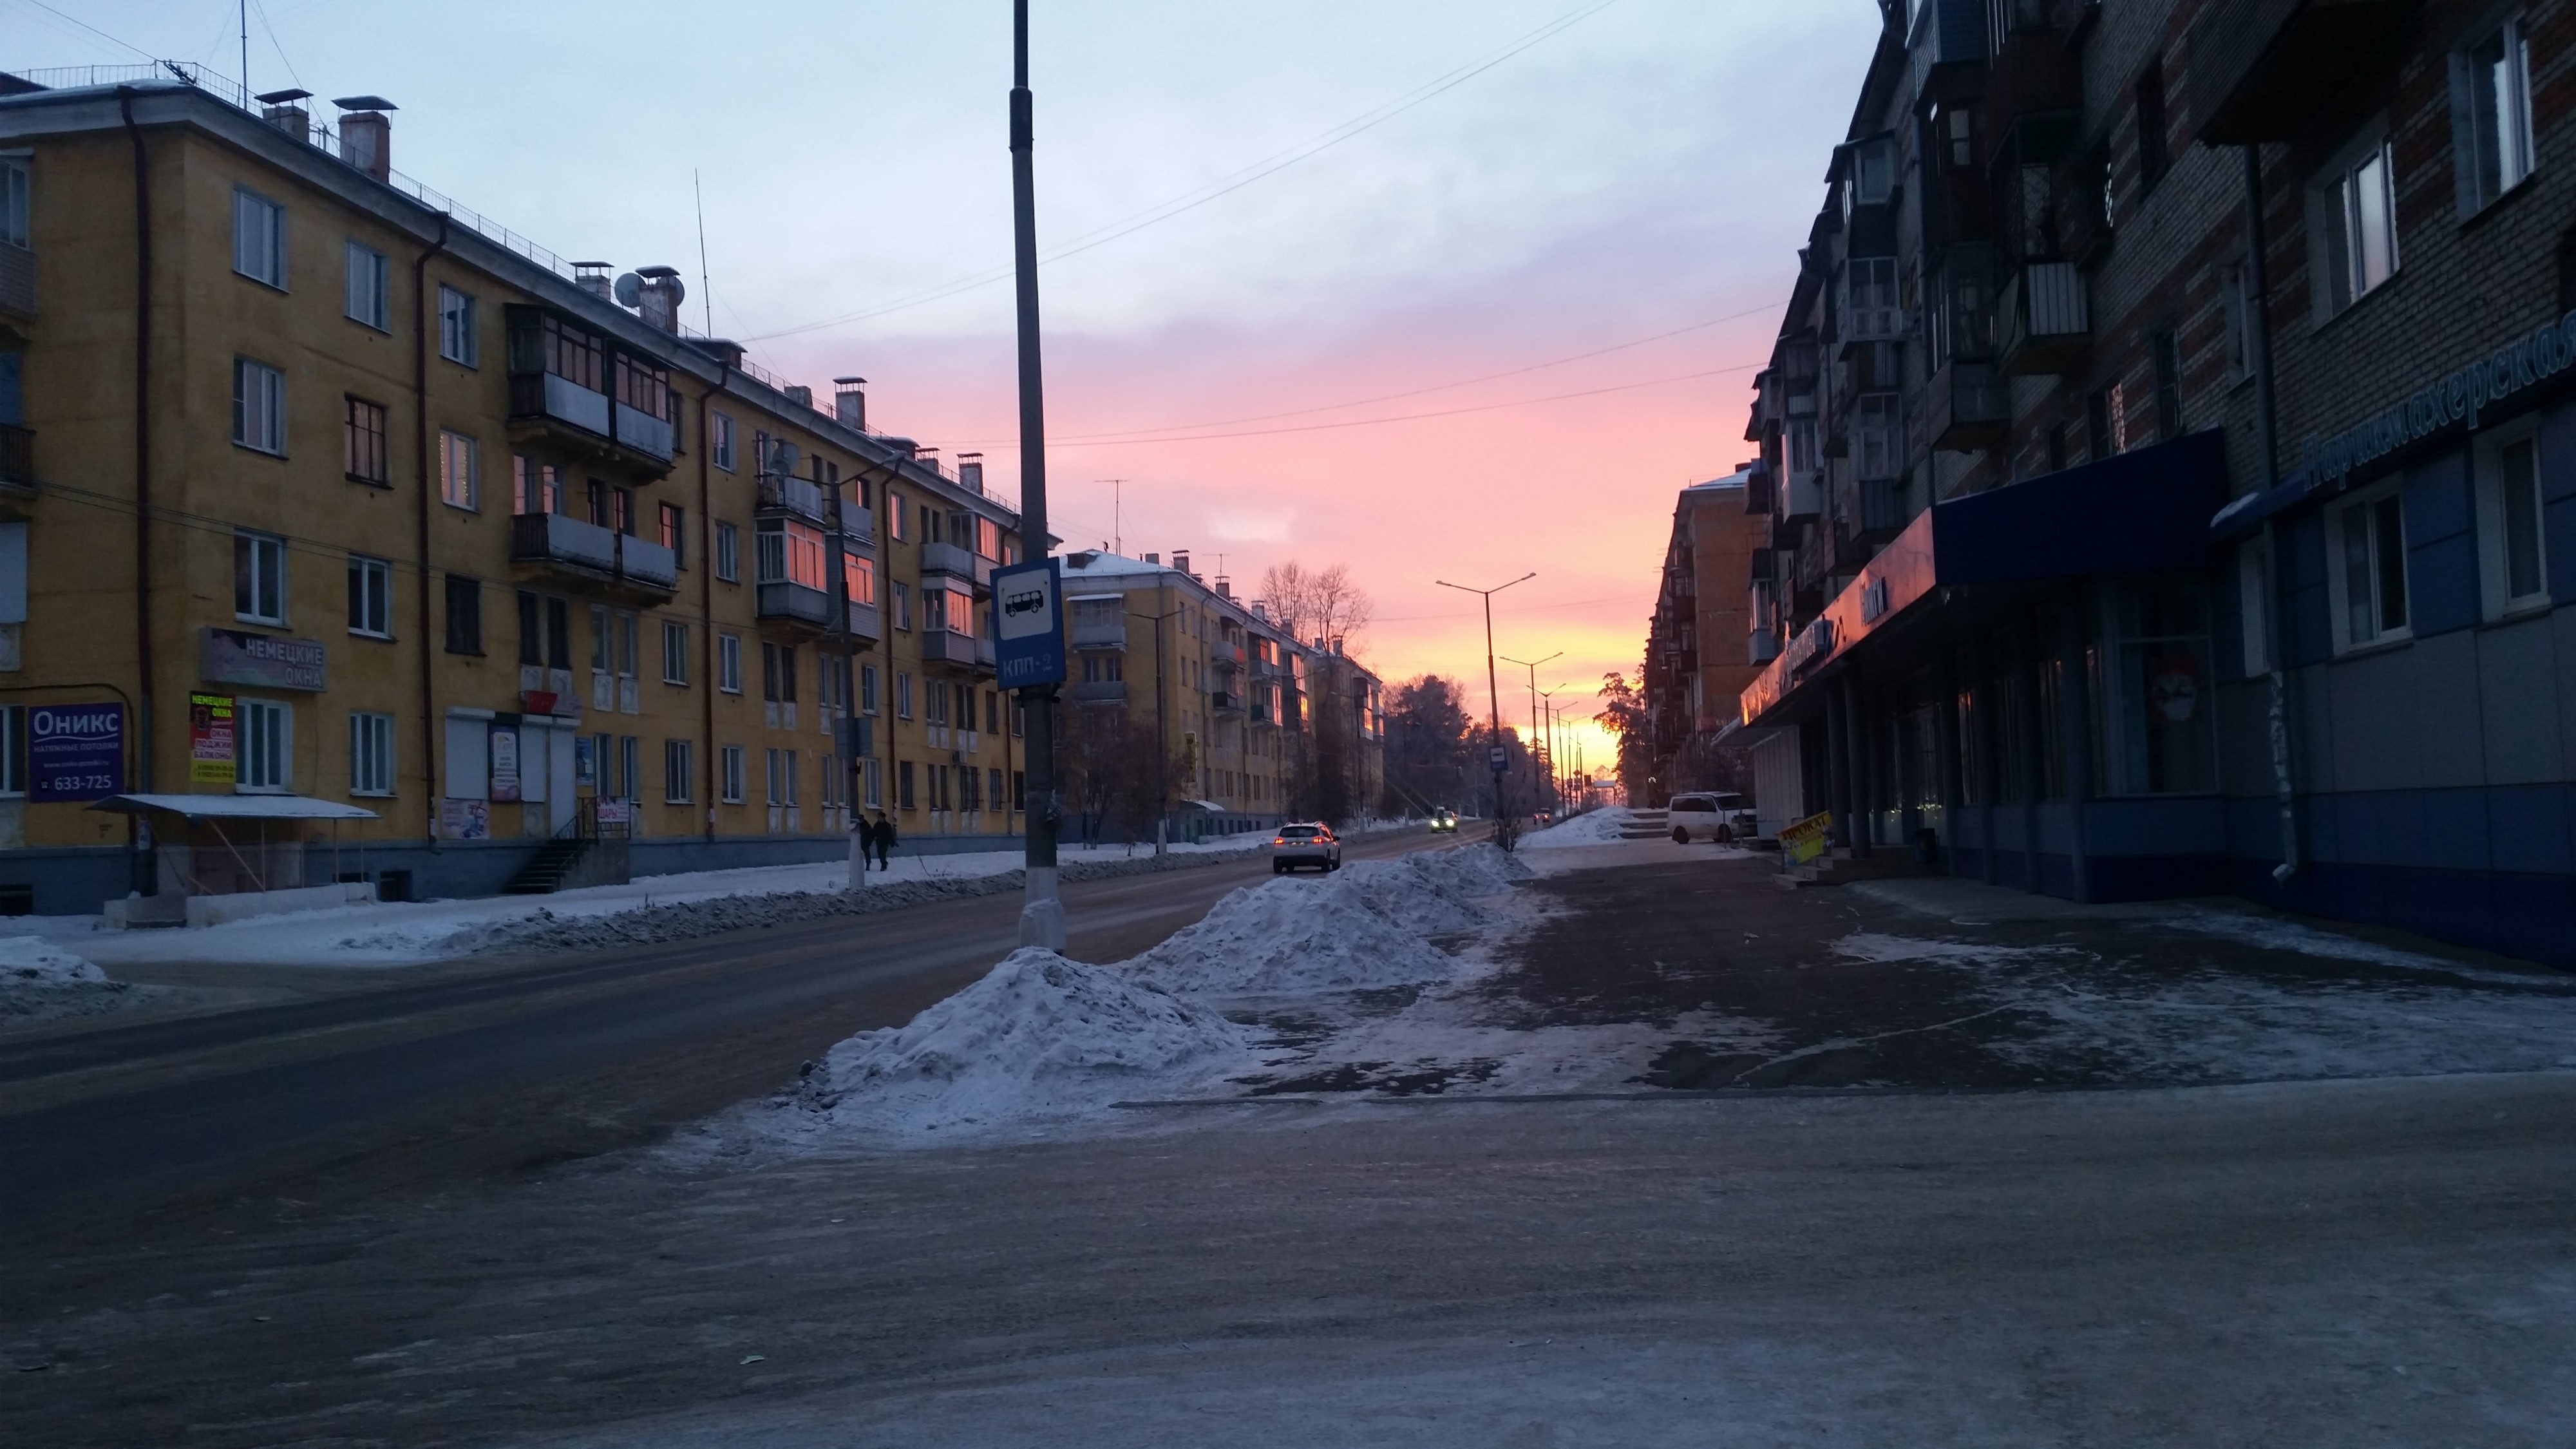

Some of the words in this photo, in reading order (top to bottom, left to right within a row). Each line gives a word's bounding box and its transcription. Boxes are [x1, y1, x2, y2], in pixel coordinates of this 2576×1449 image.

[246, 638, 323, 665] НЕМЕЦКИЕ
[1003, 653, 1052, 678] КПП-2
[285, 667, 323, 688] ОКНА
[192, 695, 233, 707] НЕМЕЦКИЕ
[212, 708, 232, 717] ОКНА
[33, 711, 118, 735] Оникс
[211, 728, 232, 738] ОКНА
[33, 744, 78, 752] НАТЯЖНЫЕ
[80, 742, 118, 751] ПОТОЛКИ
[195, 739, 232, 749] ЛОДЖИИ
[194, 750, 232, 759] БАЛКОНЫ
[55, 775, 112, 790] 633-725
[598, 808, 618, 819] ШАРЫ
[1781, 814, 1826, 840] ПРОКАТ
